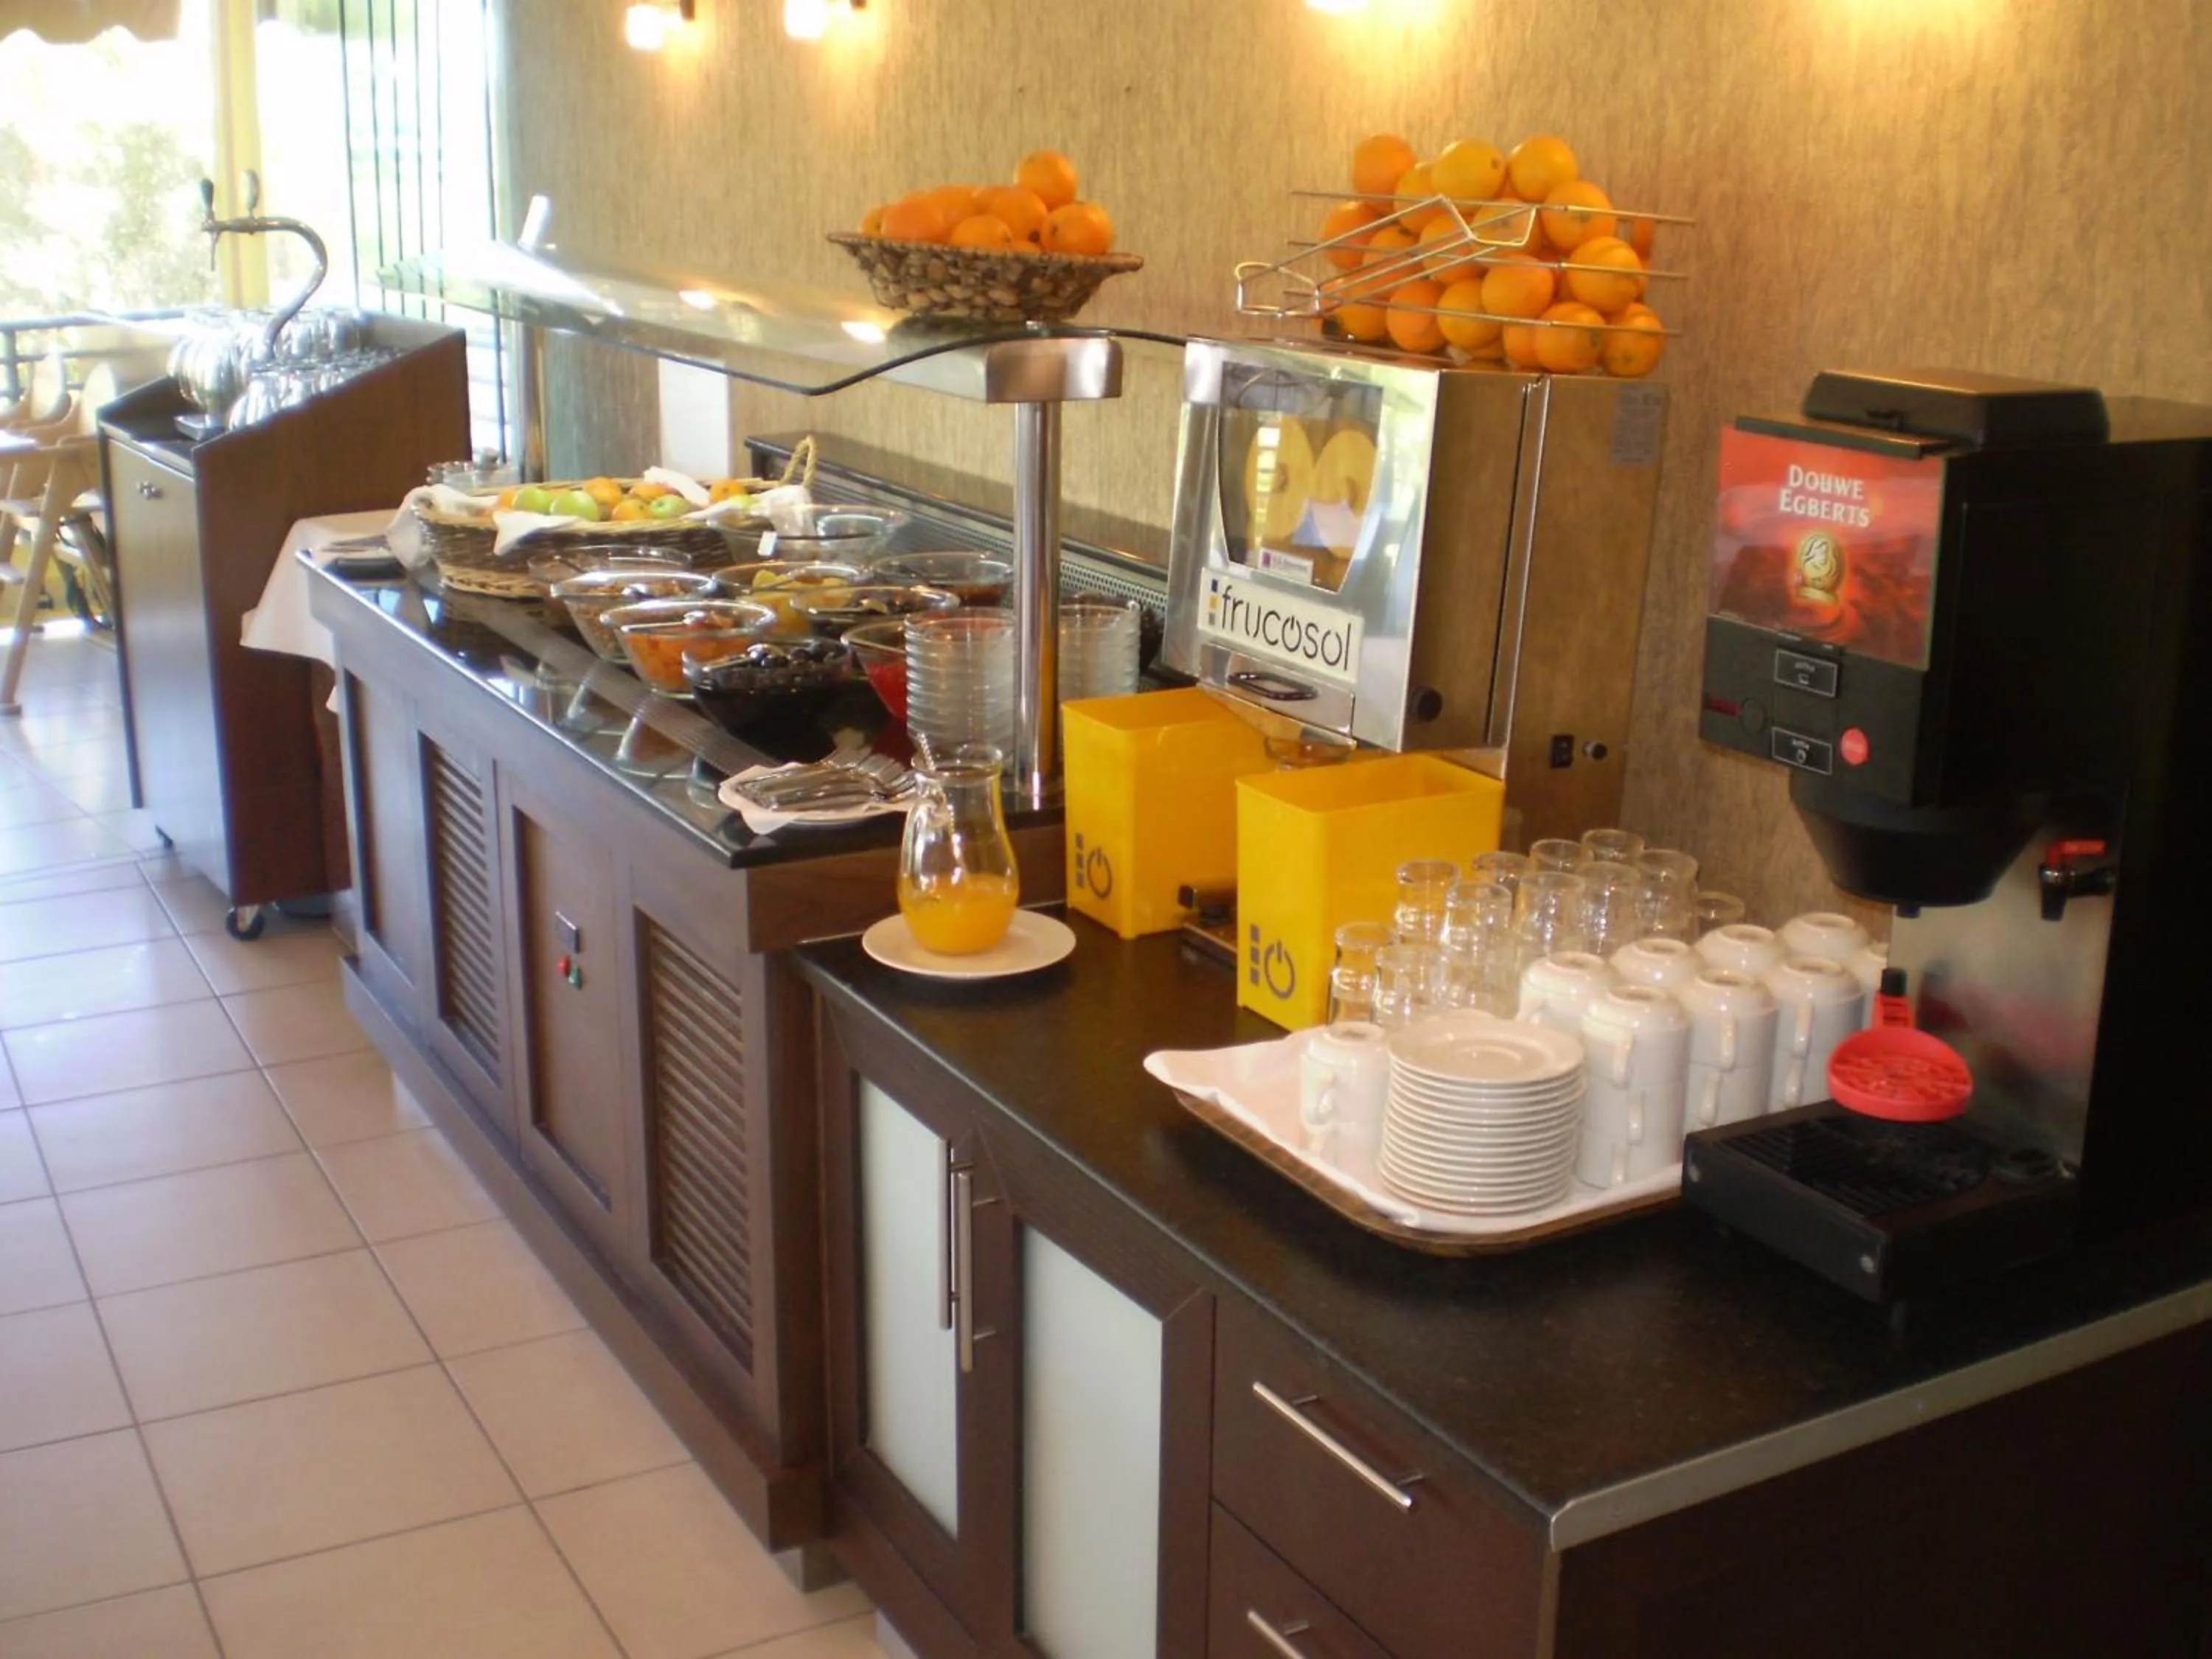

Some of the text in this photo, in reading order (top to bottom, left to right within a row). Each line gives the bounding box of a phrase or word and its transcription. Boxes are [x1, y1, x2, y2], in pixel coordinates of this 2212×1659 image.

[1788, 463, 1865, 501] DOUWE
[1778, 487, 1871, 528] EGBERTS
[1221, 585, 1352, 671] frucosol
